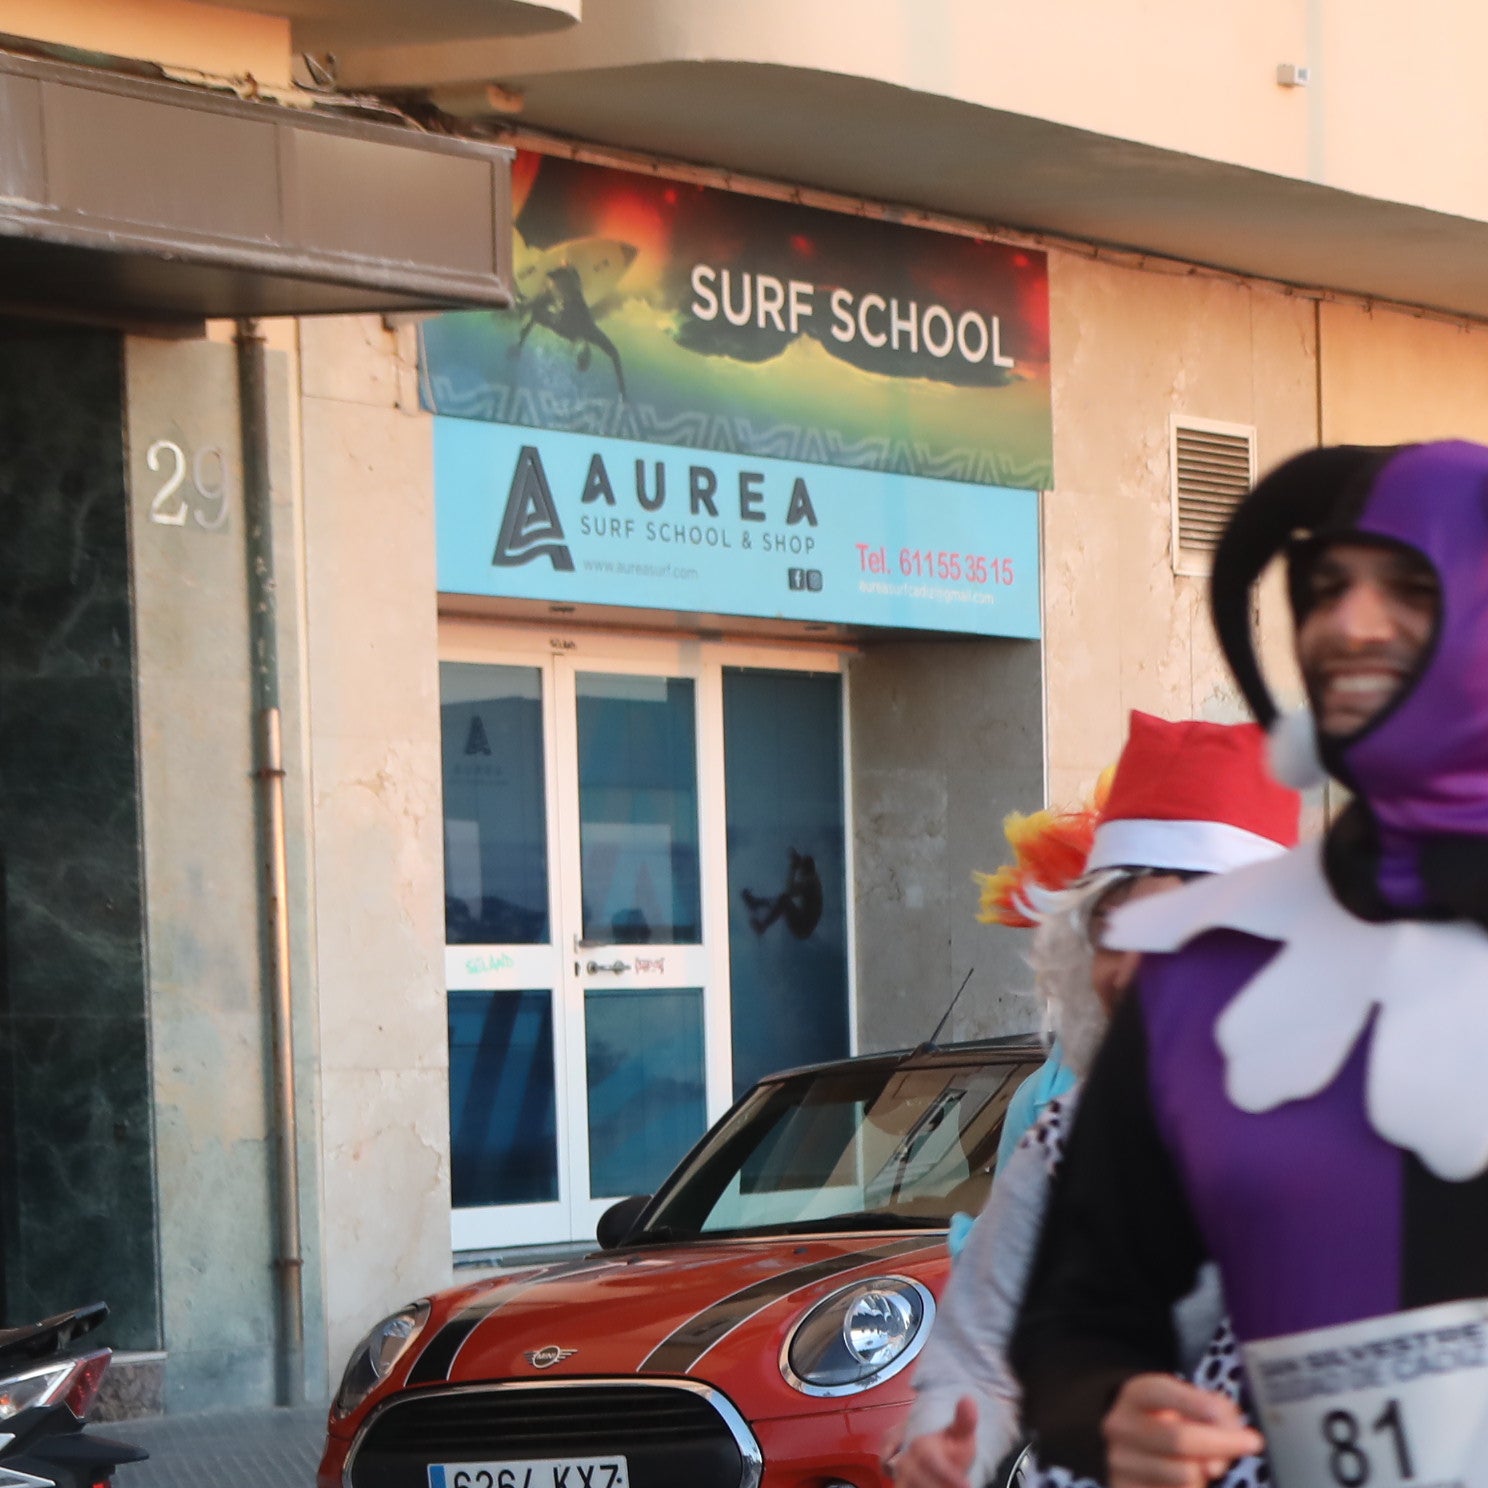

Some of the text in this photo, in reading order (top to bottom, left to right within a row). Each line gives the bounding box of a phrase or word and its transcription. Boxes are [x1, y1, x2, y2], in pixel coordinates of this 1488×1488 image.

[691, 263, 1015, 369] SURF SCHOOL
[146, 439, 229, 529] 29
[581, 454, 818, 527] AUREA
[580, 515, 816, 554] SURF SCHOOL & SHOP
[855, 542, 891, 574] Tel.
[583, 558, 698, 581] www.aureasurf.com
